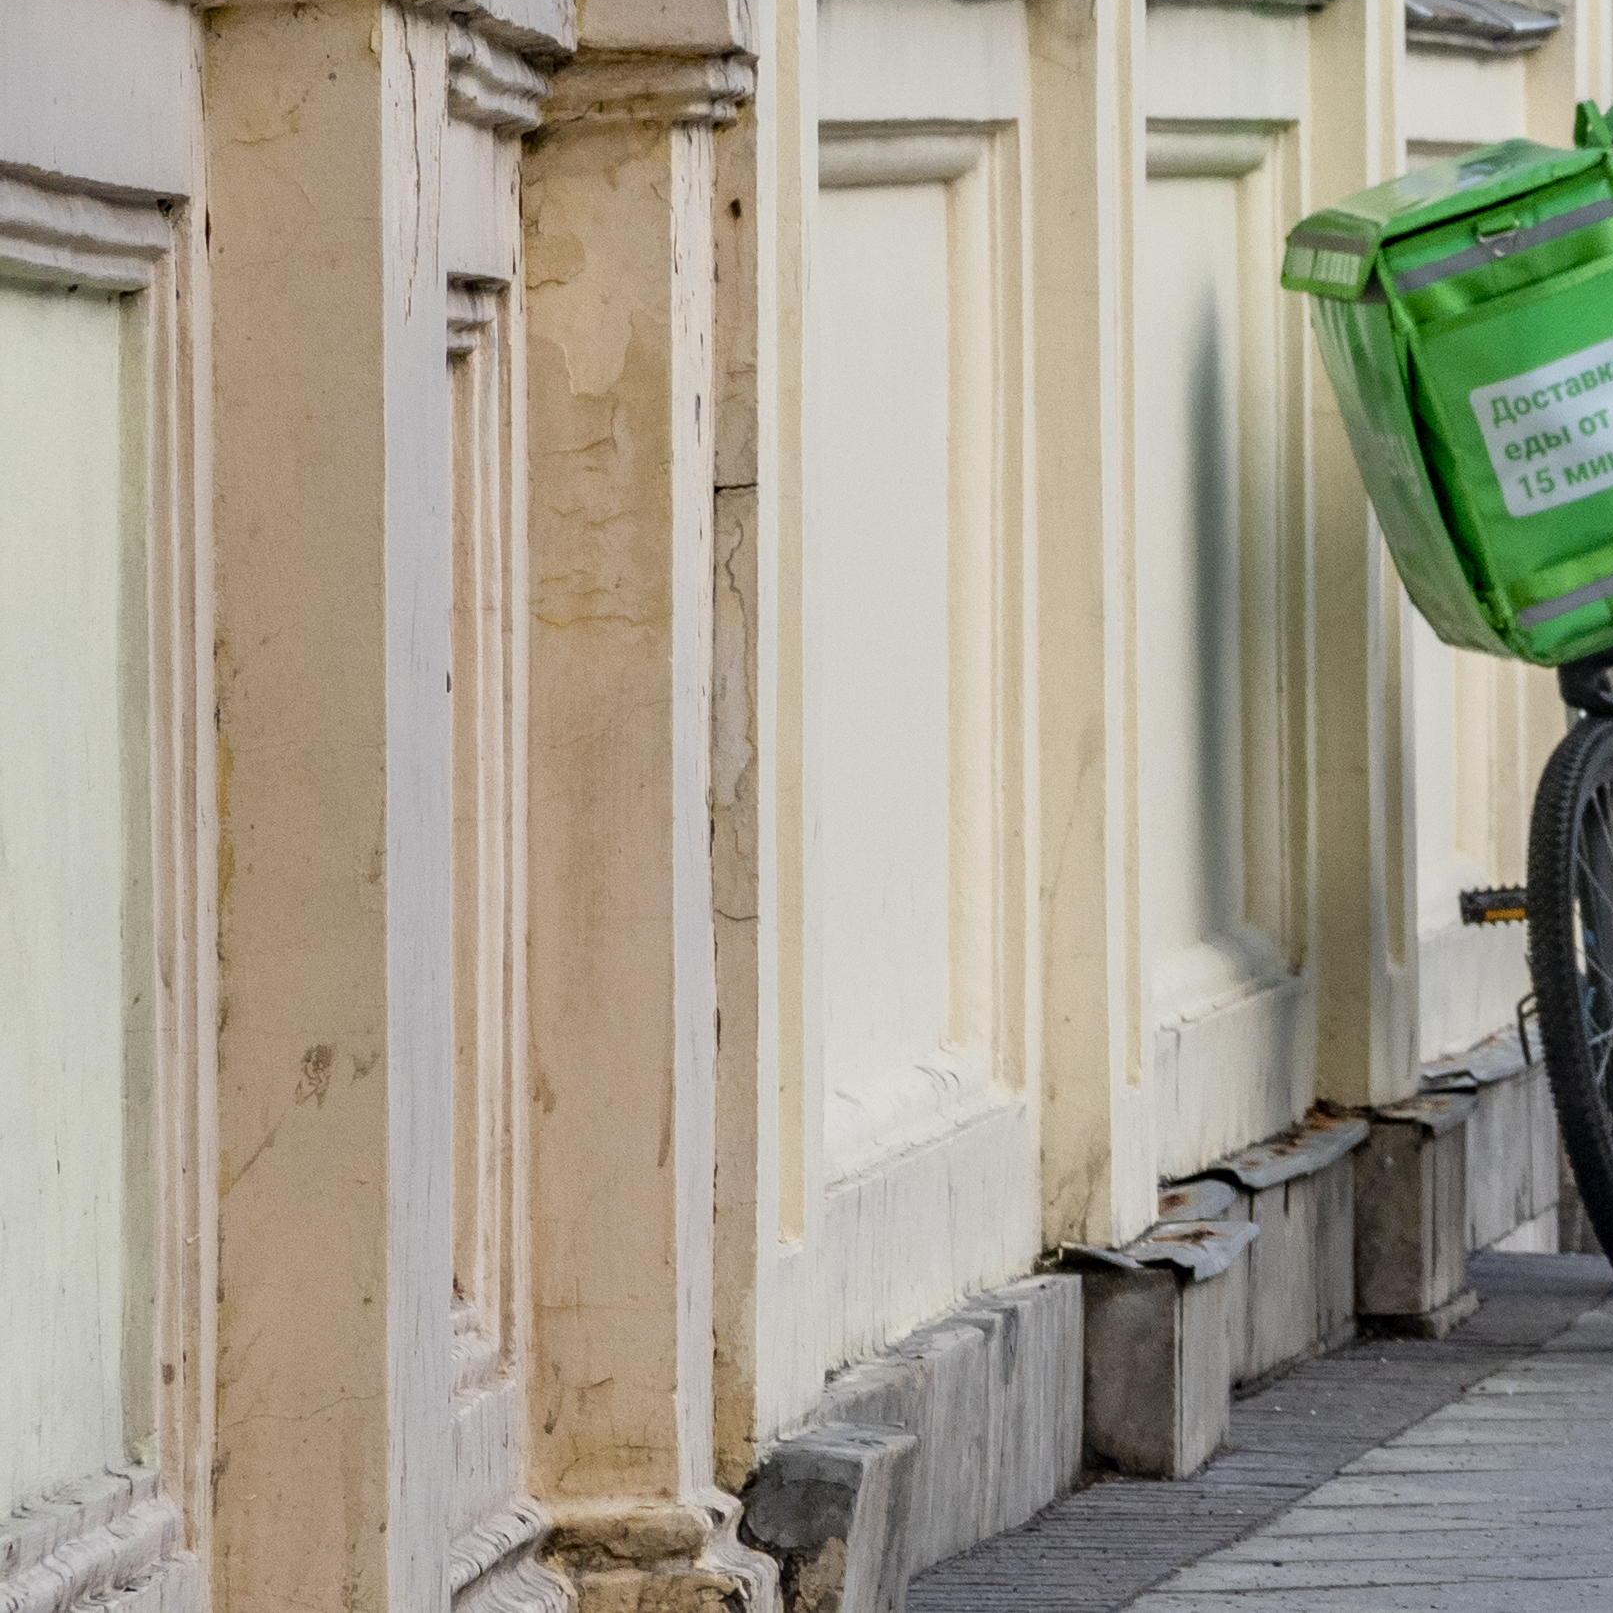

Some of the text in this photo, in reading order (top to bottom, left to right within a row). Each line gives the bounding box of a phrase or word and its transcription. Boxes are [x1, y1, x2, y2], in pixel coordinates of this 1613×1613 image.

[1504, 408, 1610, 462] еды от
[1518, 467, 1556, 500] 15
